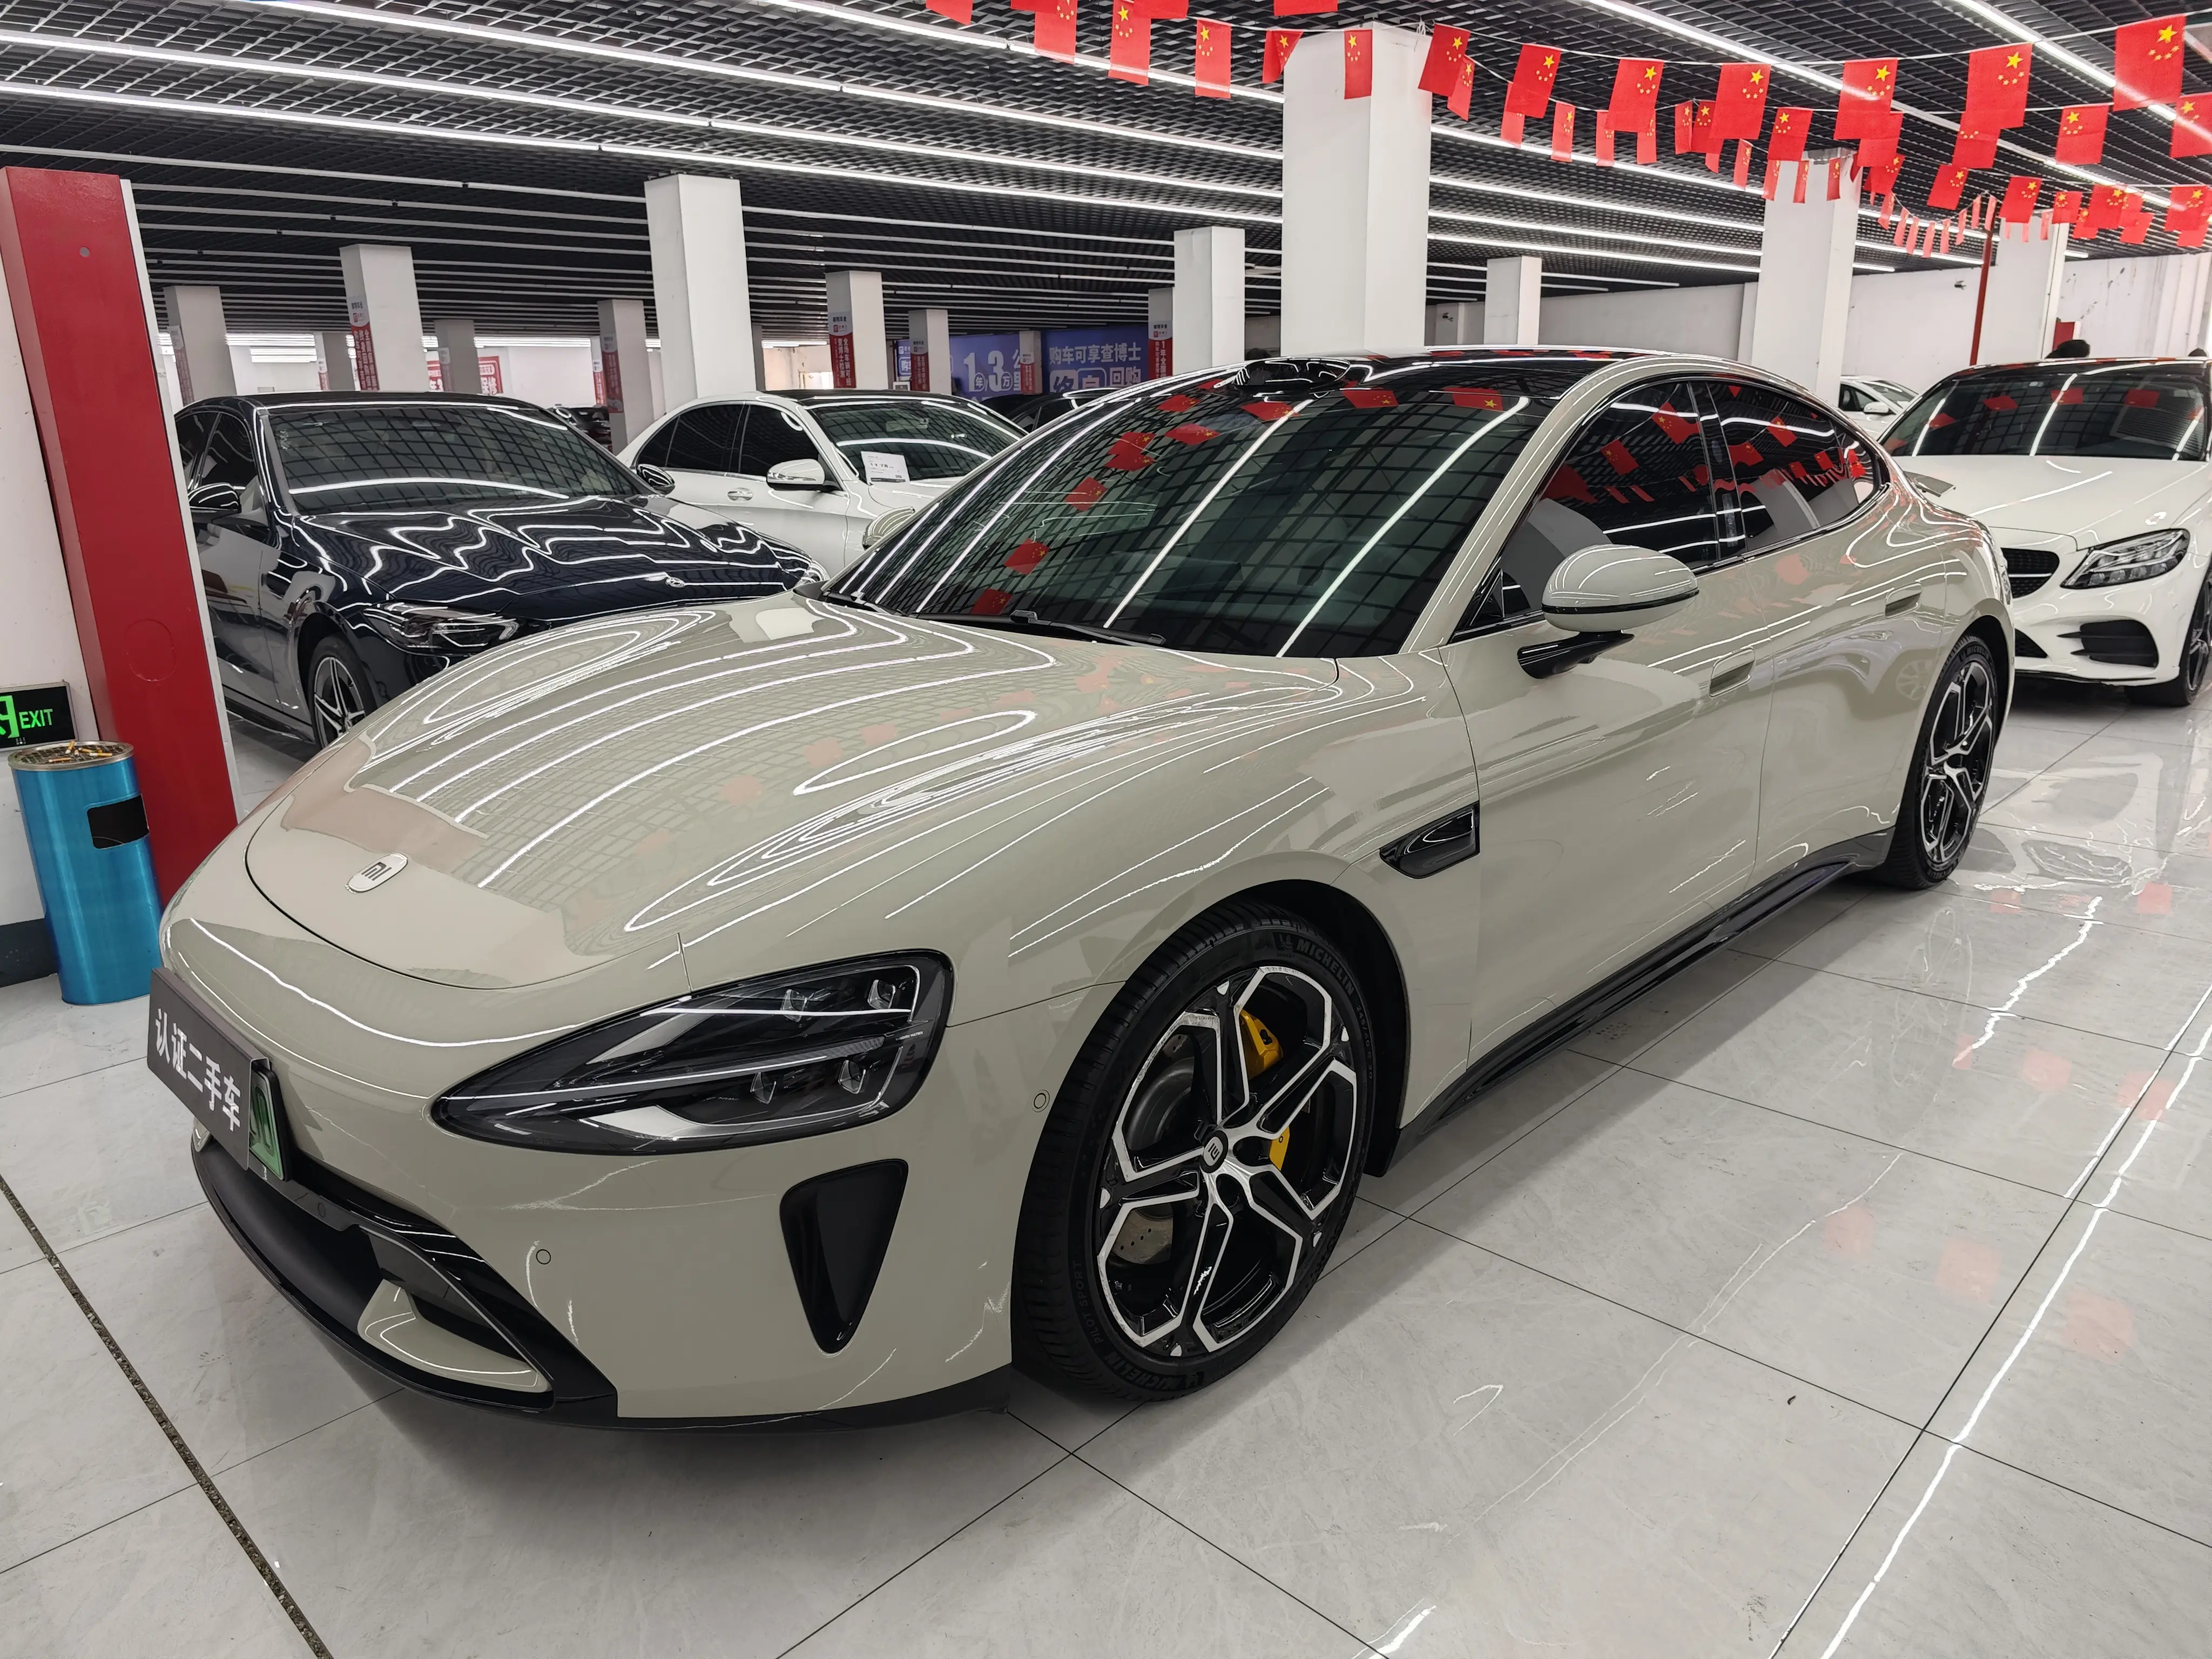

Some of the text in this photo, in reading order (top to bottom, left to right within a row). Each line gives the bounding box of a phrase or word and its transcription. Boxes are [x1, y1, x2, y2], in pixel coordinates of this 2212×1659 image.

[1049, 342, 1142, 365] 购车可享查博士
[18, 708, 53, 729] EXIT
[1296, 939, 1355, 997] MICHELIN
[155, 1008, 241, 1132] 认证二手车
[1072, 1259, 1104, 1345] PILOT SPORT
[1104, 1351, 1182, 1391] MICHELIN
